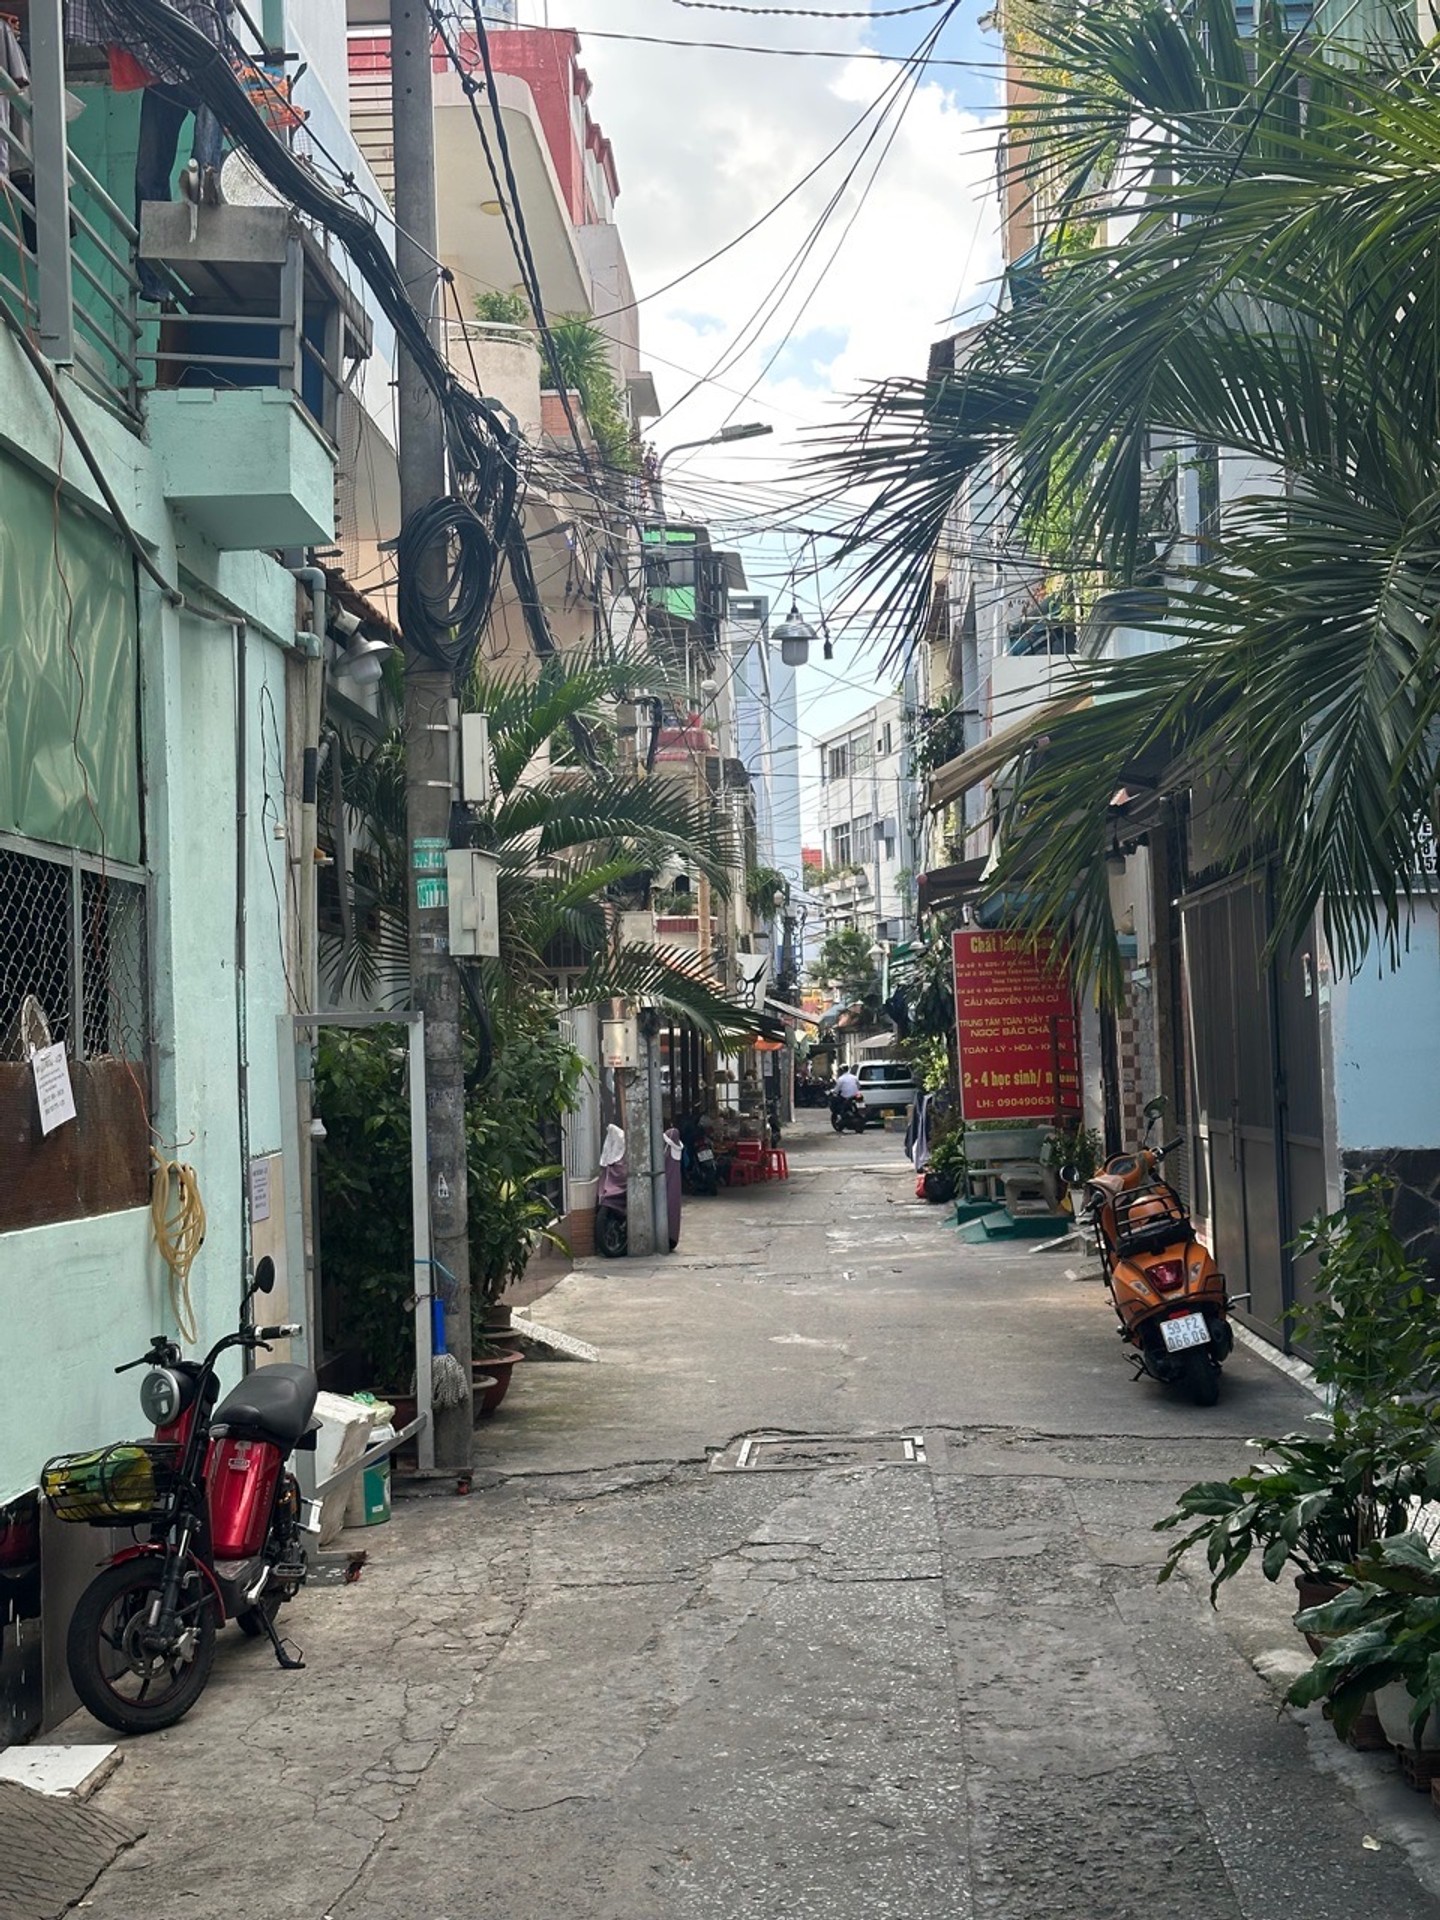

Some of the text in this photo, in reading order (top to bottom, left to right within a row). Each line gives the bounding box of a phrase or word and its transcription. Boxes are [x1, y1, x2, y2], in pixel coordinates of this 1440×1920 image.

[1027, 1024, 1050, 1035] CHÂ
[964, 1072, 972, 1088] 2
[980, 1071, 988, 1087] 4
[991, 1071, 1011, 1090] học
[976, 1095, 1065, 1109] LH: 09049063
